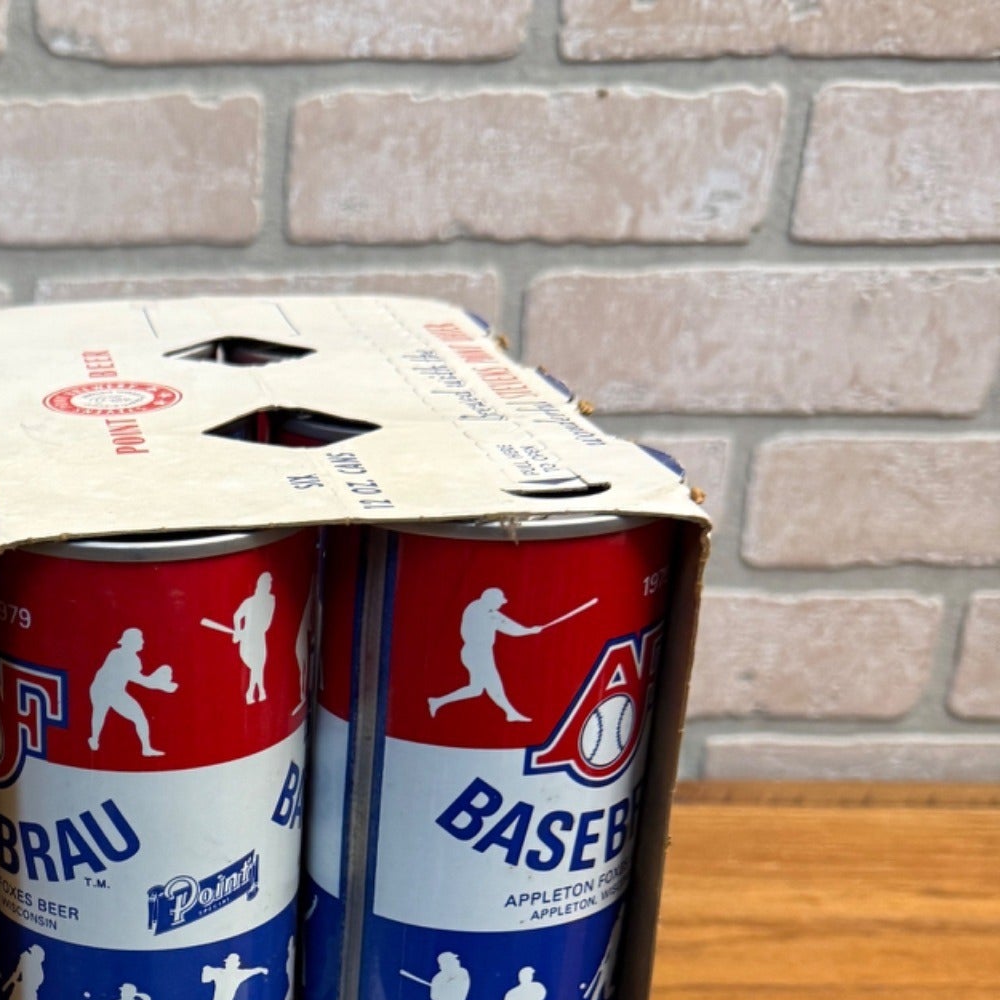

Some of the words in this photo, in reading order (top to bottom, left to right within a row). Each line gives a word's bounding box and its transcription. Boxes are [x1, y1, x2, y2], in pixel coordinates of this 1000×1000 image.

[82, 350, 118, 378] BEER
[105, 419, 149, 455] POINT
[359, 499, 394, 509] 12
[163, 855, 256, 926] Point
[504, 879, 595, 908] APPLETON
[38, 898, 79, 921] BEER
